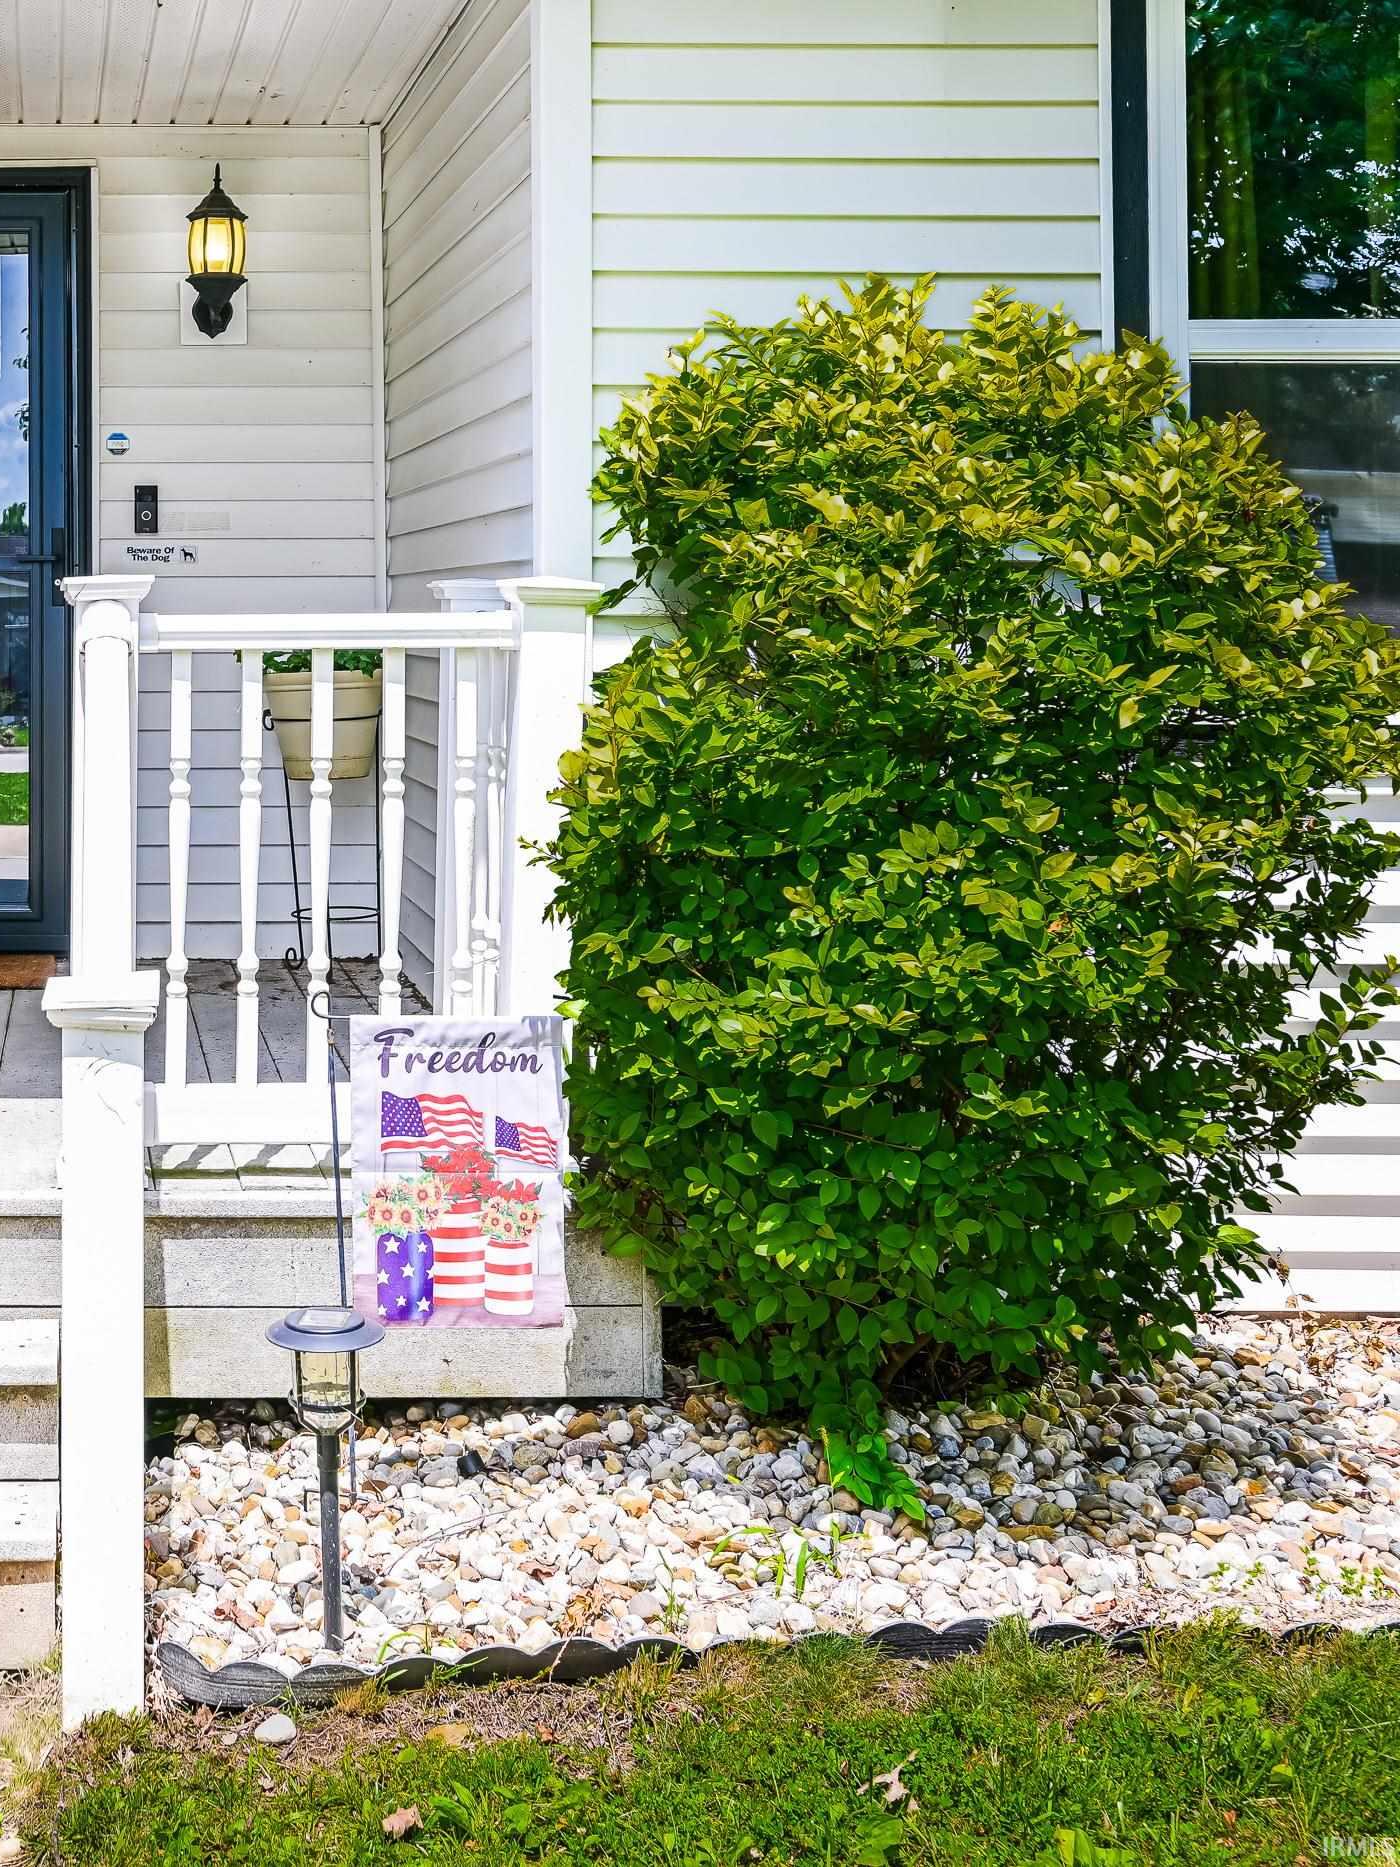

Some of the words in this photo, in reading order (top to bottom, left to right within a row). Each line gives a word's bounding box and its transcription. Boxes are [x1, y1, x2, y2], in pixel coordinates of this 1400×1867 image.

[126, 546, 162, 554] Beware
[164, 546, 176, 554] Of
[132, 553, 149, 562] The
[151, 553, 171, 563] Dog
[374, 1027, 544, 1079] Freedom
